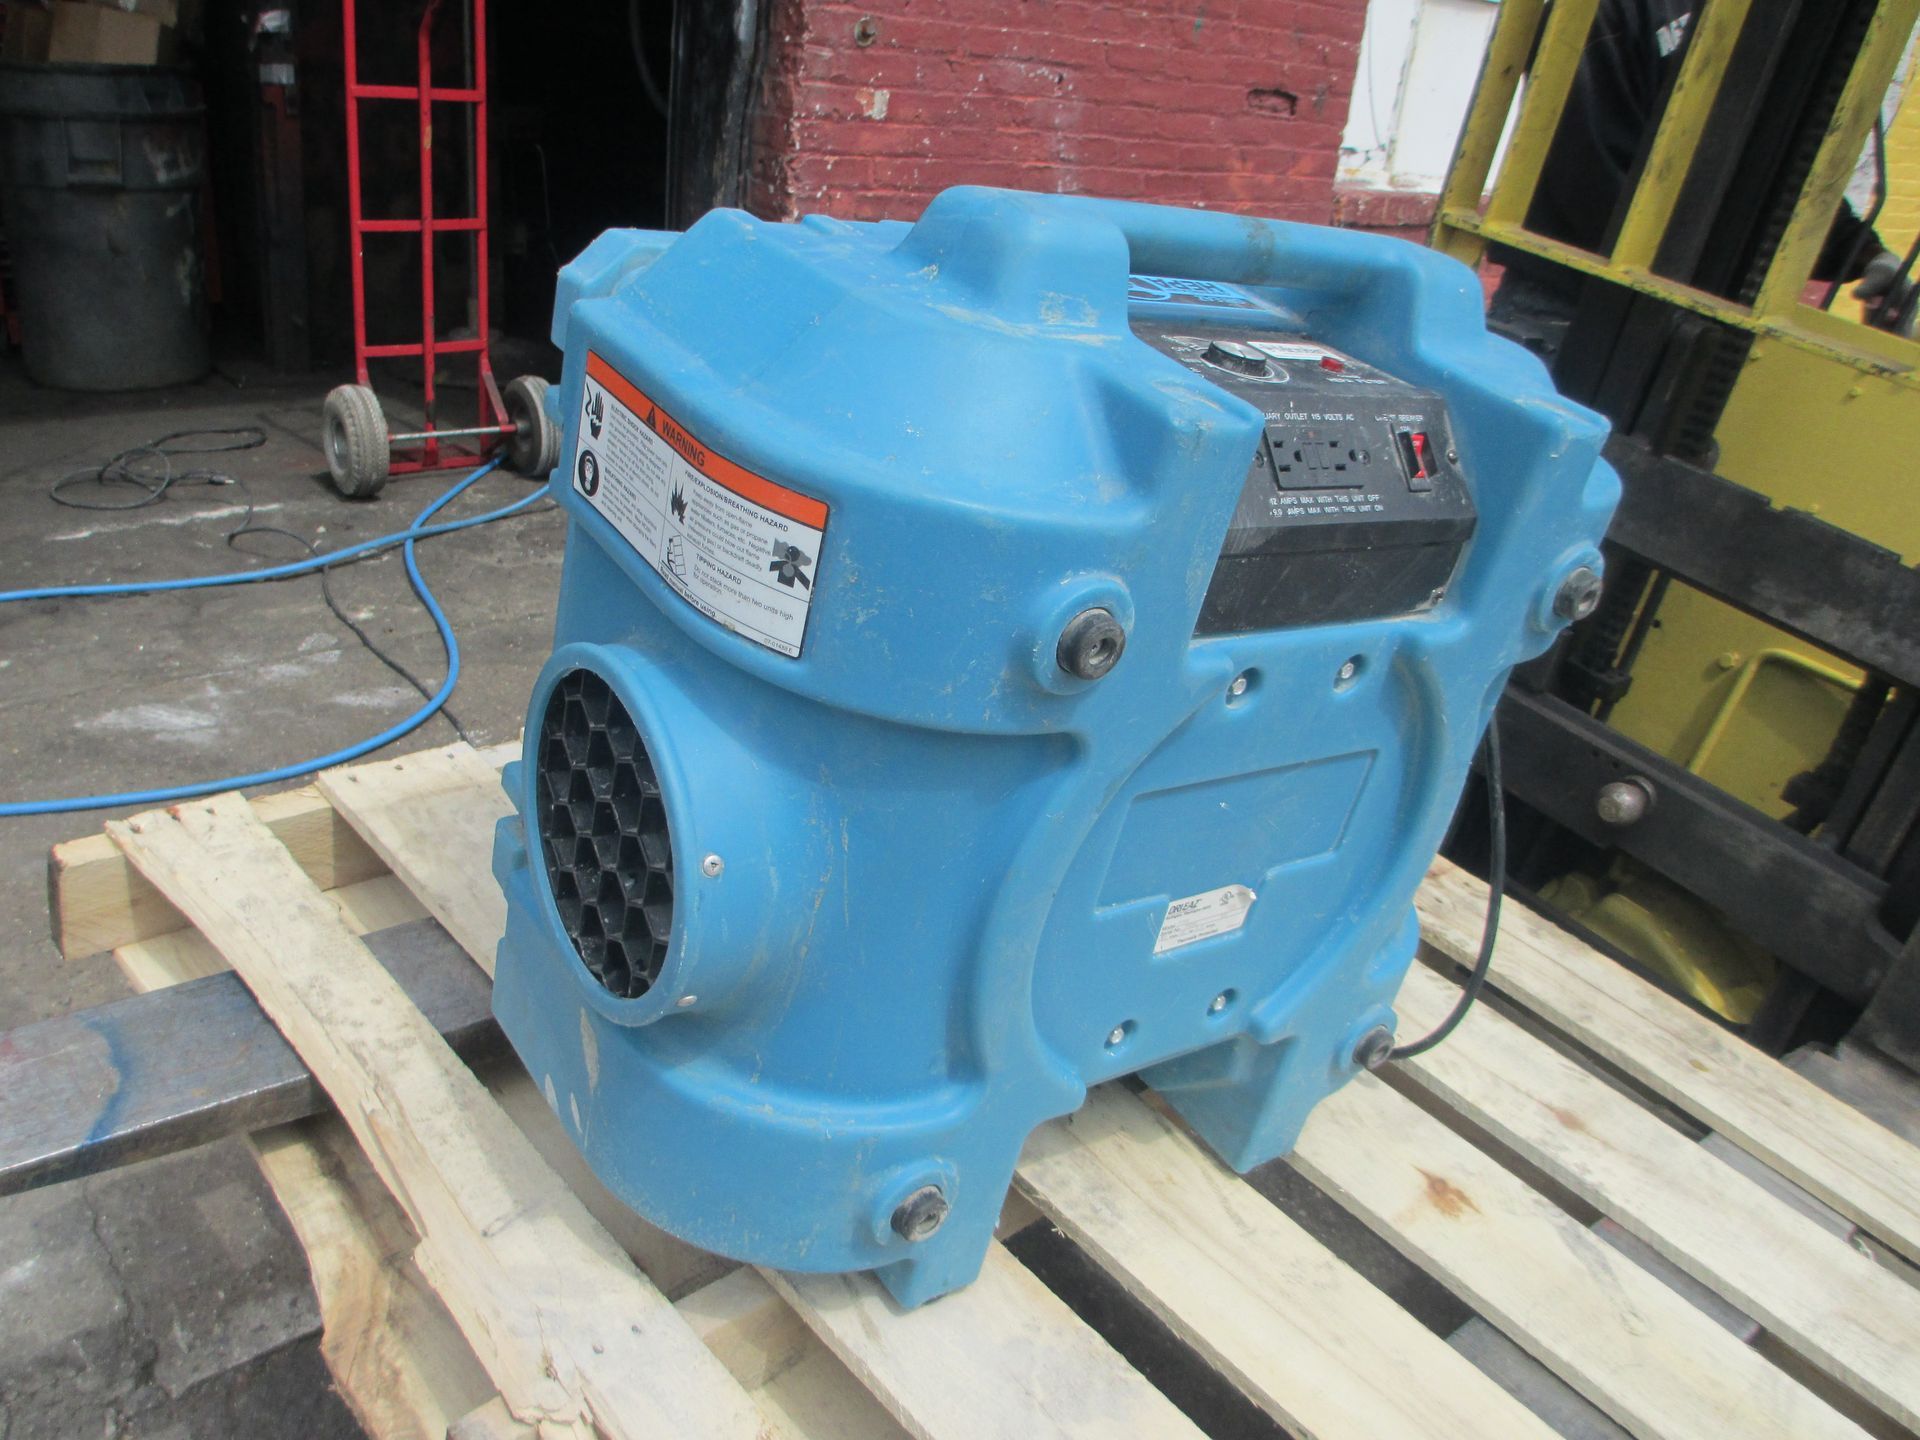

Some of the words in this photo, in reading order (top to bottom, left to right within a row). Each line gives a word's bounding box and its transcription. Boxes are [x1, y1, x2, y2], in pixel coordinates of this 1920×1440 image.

[1283, 412, 1308, 420] OUTLET
[1323, 413, 1343, 421] VOLTS
[1345, 413, 1354, 421] AC
[662, 418, 706, 467] WARNING
[1280, 497, 1298, 505] AMPS
[1300, 496, 1314, 504] MAX
[1316, 495, 1333, 504] WITH
[1334, 494, 1349, 503] THIS
[1351, 494, 1365, 503] UNIT
[1367, 494, 1380, 502] OFF
[1287, 507, 1305, 515] AMPS
[1307, 507, 1321, 515] MAX
[1323, 506, 1340, 514] WITH
[1342, 505, 1356, 513] THIS
[1358, 505, 1371, 513] UNIT
[1374, 504, 1384, 512] ON
[760, 515, 789, 533] HAZARD
[695, 553, 716, 571] TIPPING
[717, 566, 742, 585] HAZARD
[684, 589, 700, 606] before
[723, 583, 738, 596] more
[738, 590, 751, 602] than
[751, 597, 763, 608] two
[763, 604, 779, 616] units
[779, 609, 794, 621] high
